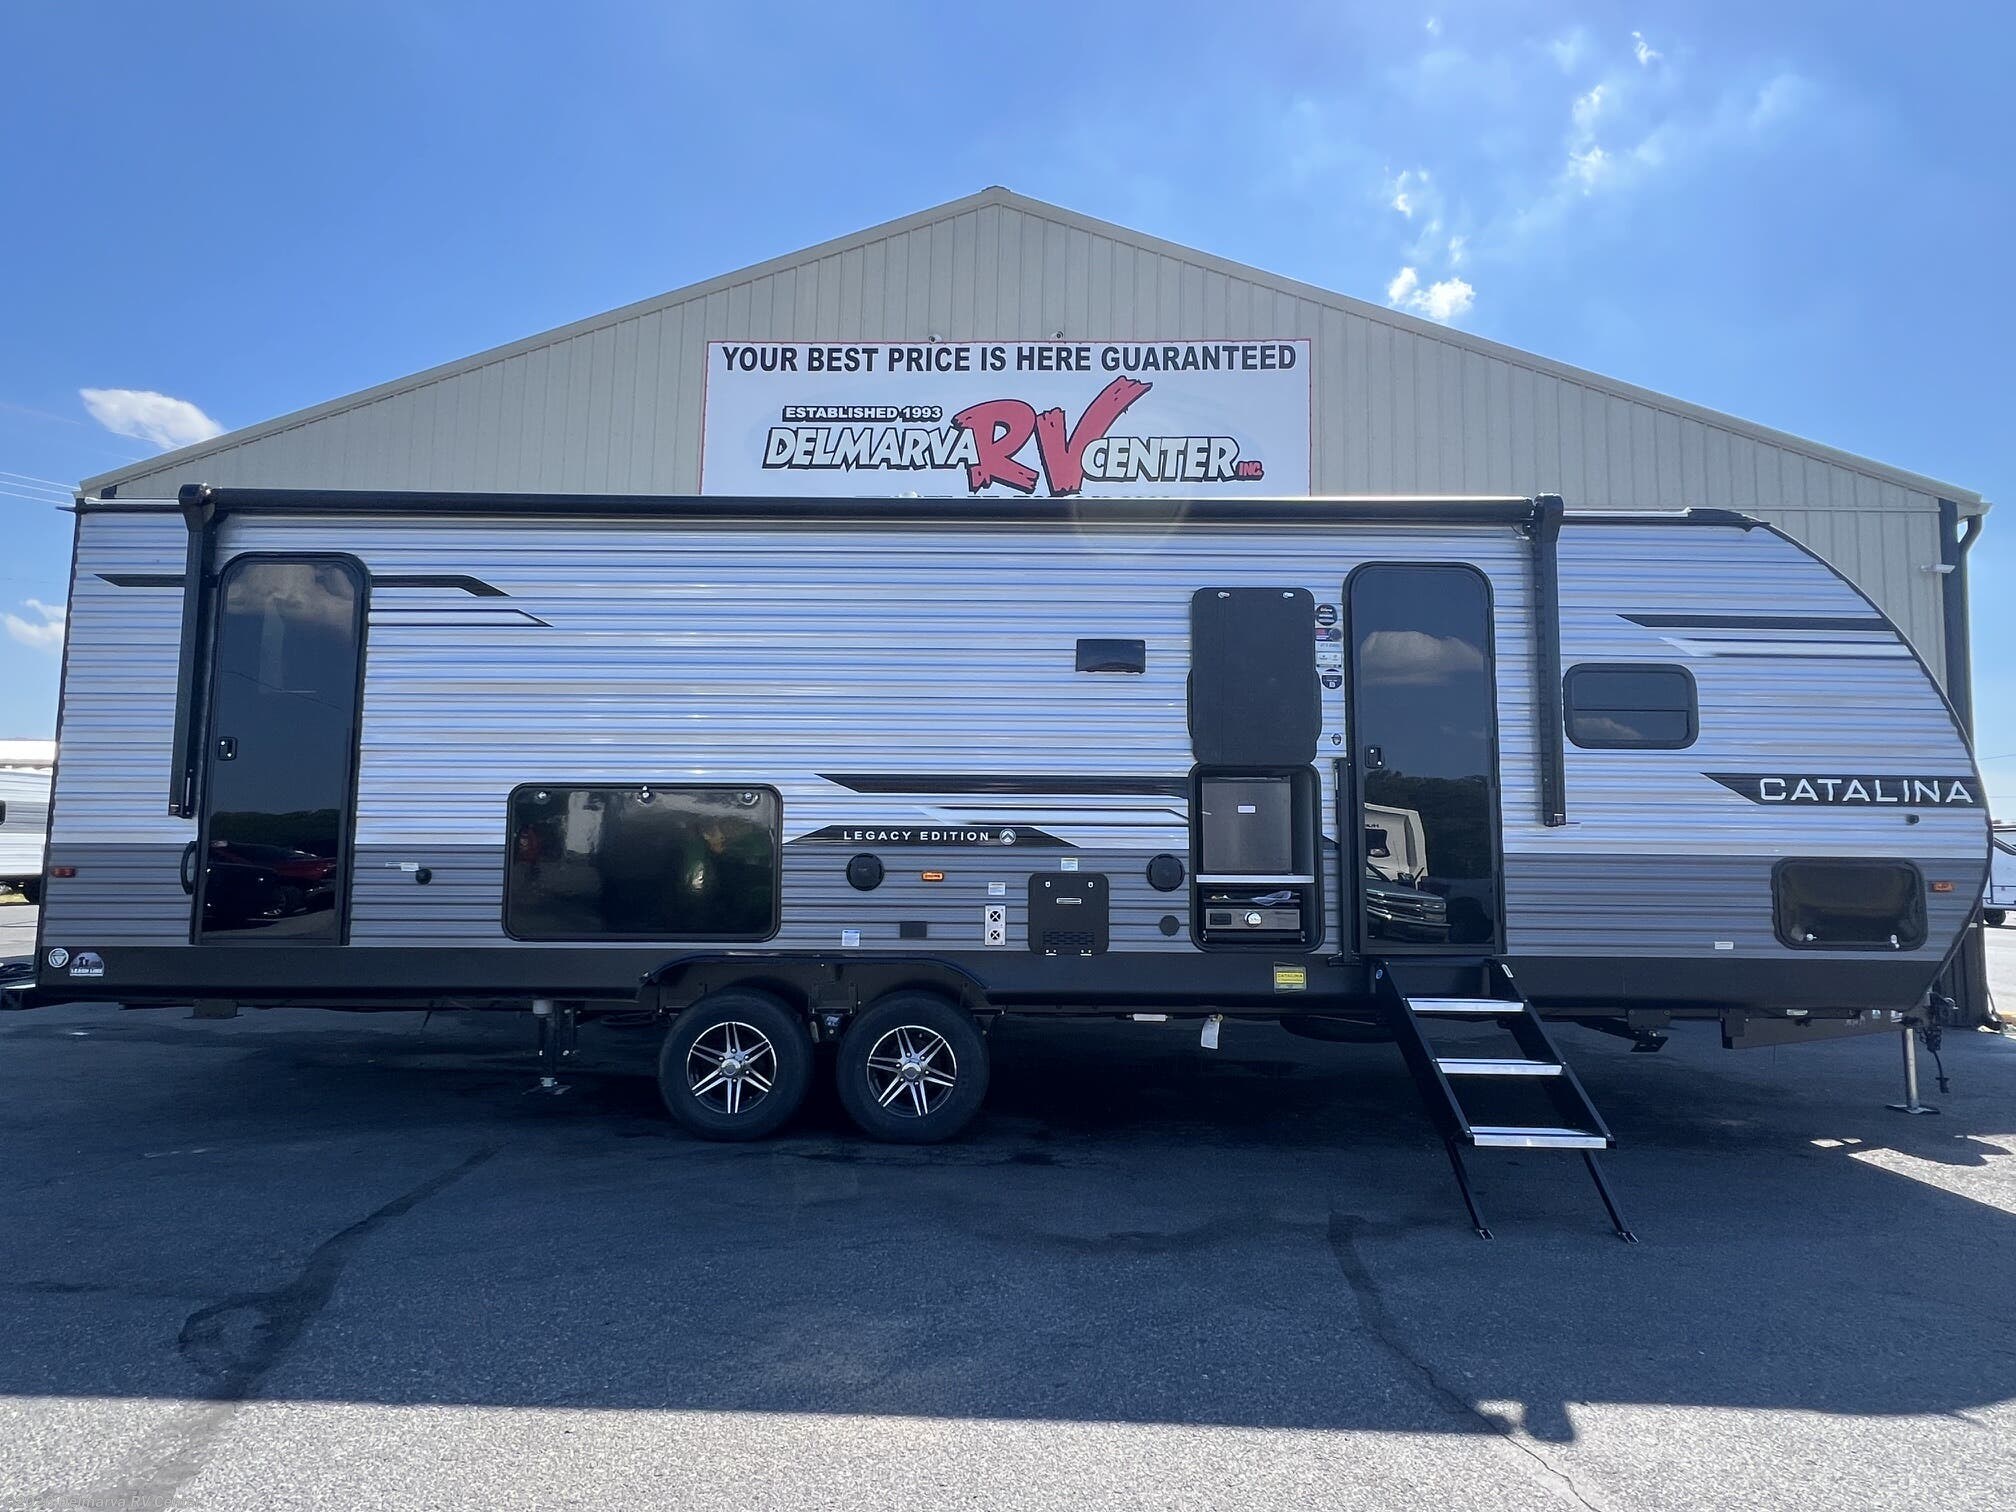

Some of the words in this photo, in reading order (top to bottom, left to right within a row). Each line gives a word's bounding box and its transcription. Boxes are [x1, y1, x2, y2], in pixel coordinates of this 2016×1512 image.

[722, 346, 798, 371] YOUR
[807, 347, 878, 372] BEST
[888, 347, 970, 371] PRICE
[981, 347, 1006, 371] IS
[1017, 347, 1091, 371] HERE
[1101, 345, 1297, 371] GUARANTEED
[785, 406, 898, 420] ESTABLISHED
[902, 406, 942, 419] 1993
[763, 427, 982, 470] DELMARVA
[951, 375, 1153, 496] RV
[1081, 436, 1240, 482] CENTER
[1759, 777, 1974, 803] CATALINA
[843, 830, 912, 841] LEGACY
[919, 831, 989, 842] EDITION
